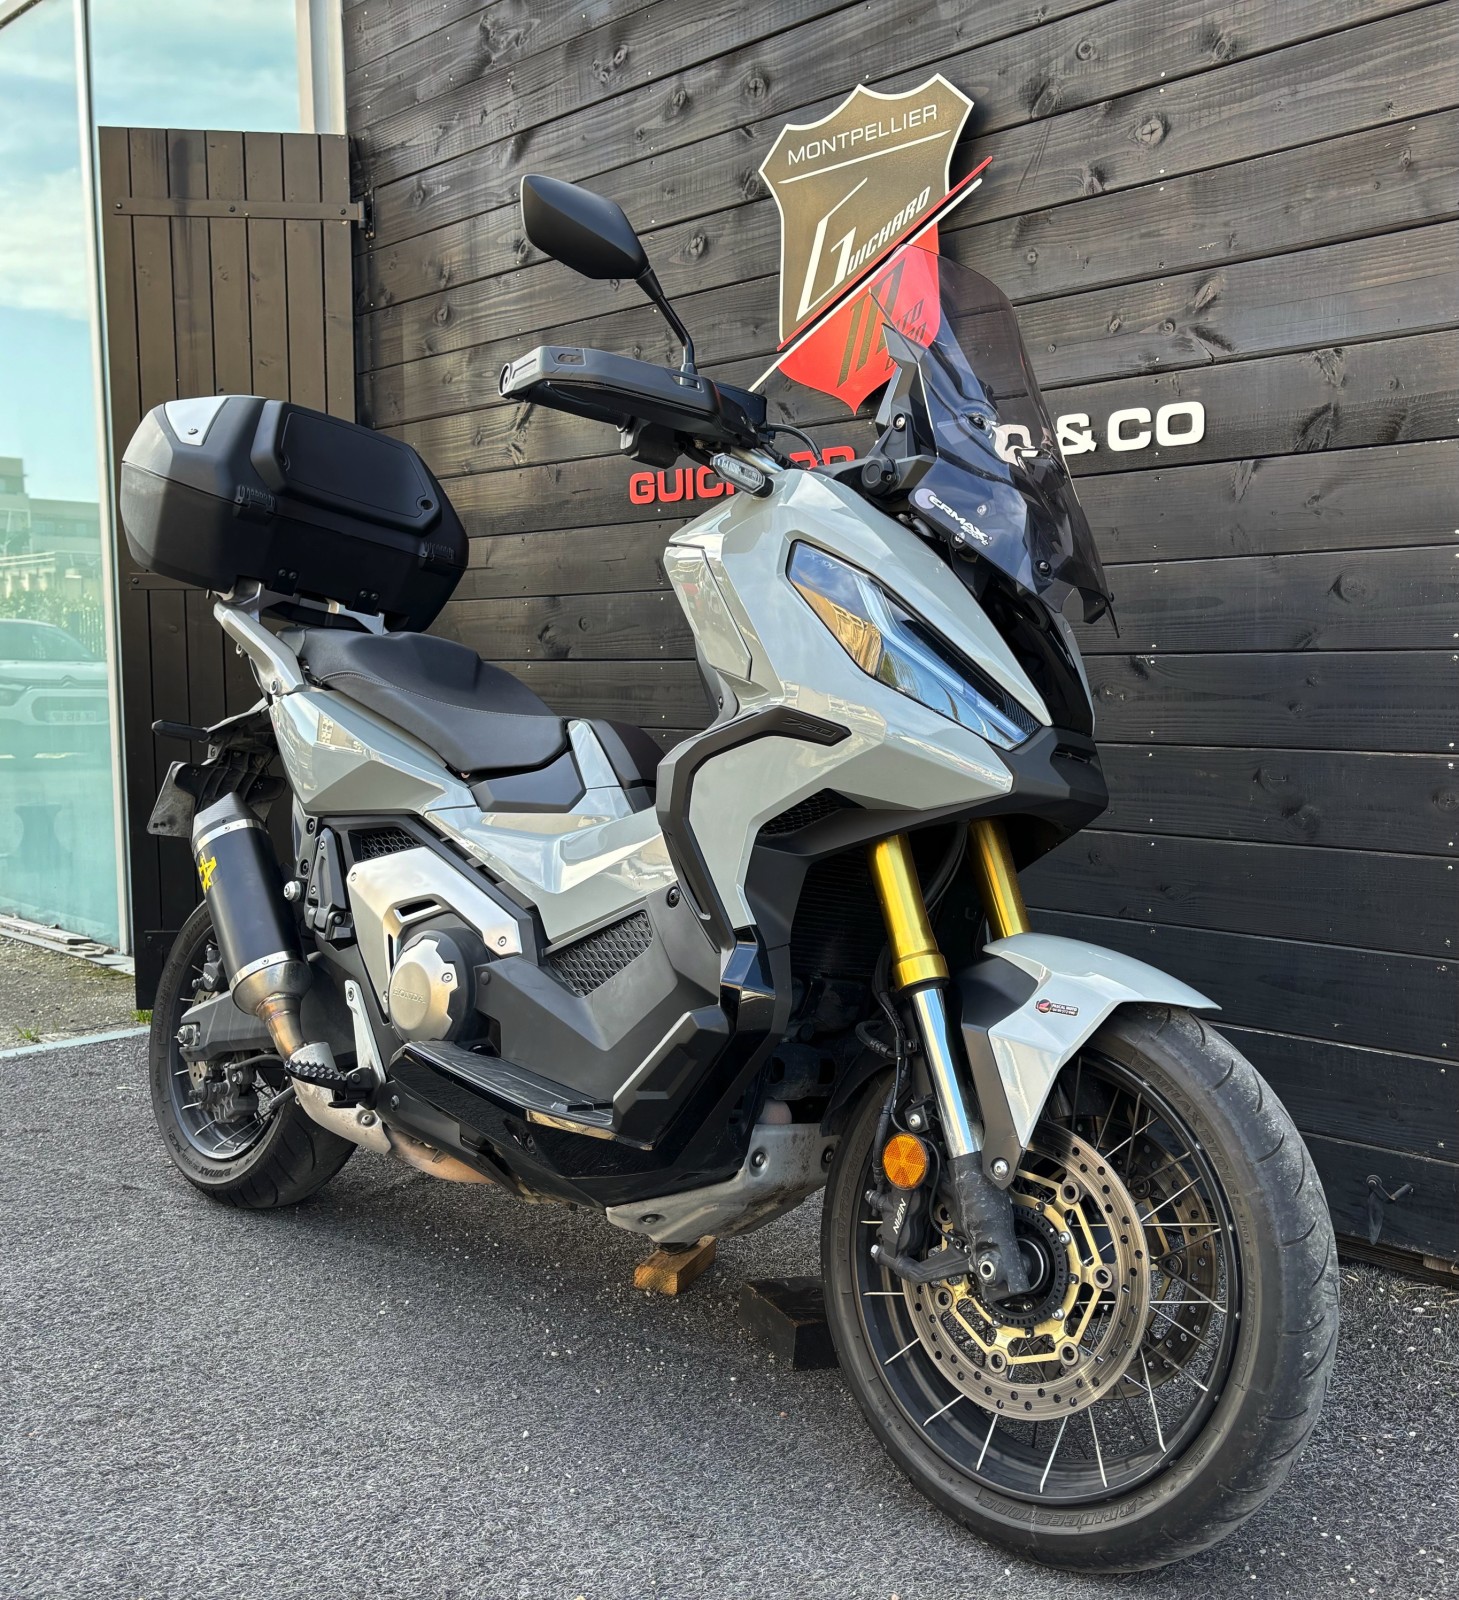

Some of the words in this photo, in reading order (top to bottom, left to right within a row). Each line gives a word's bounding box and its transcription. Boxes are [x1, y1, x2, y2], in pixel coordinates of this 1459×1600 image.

[788, 104, 937, 165] MONTPELLIER
[796, 177, 931, 322] GUICHARD
[1056, 413, 1097, 455] &
[1107, 401, 1205, 452] CO
[392, 985, 427, 1005] HONDA
[892, 1197, 907, 1235] NISSIN
[981, 1496, 1137, 1526] BRIDGESTONE
